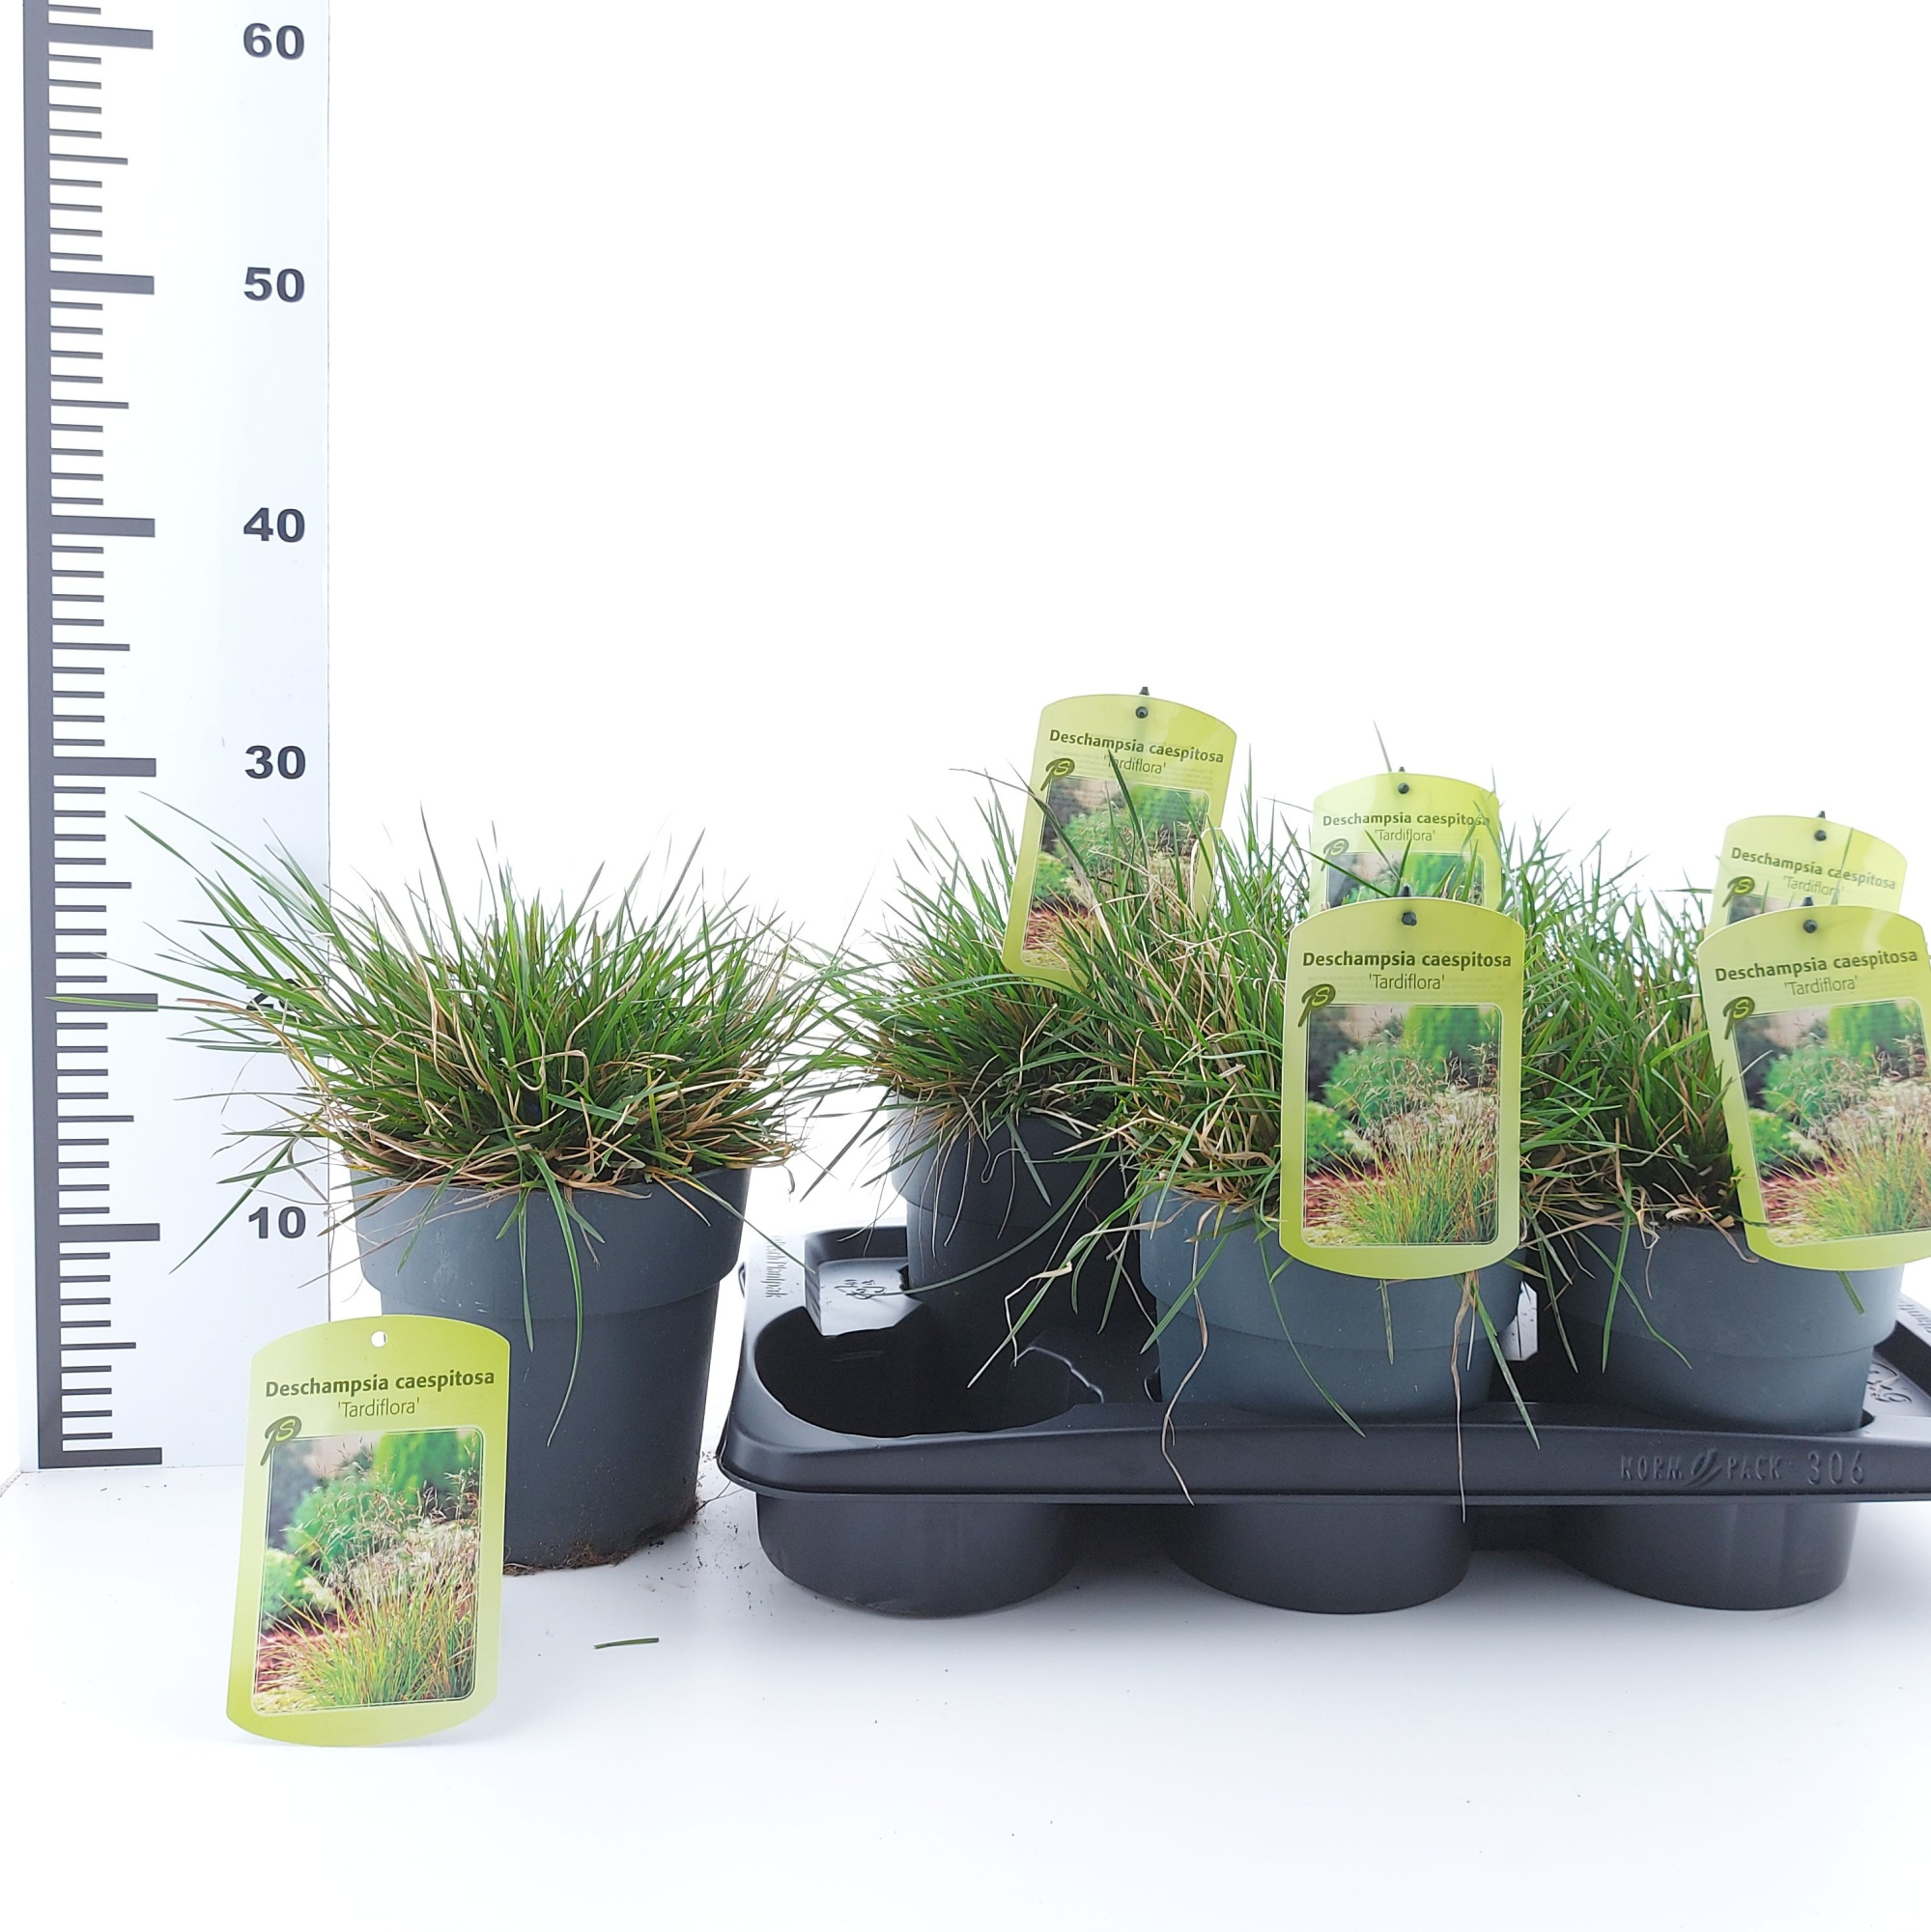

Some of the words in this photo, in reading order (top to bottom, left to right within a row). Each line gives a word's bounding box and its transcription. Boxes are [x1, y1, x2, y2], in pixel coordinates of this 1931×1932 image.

[243, 23, 305, 60] 60
[243, 268, 305, 302] 50
[243, 508, 305, 543] 40
[1049, 729, 1144, 753] Deschampsia
[1150, 742, 1224, 763] caespitosa
[244, 746, 306, 780] 30
[1323, 811, 1411, 827] Deschampsia
[1375, 829, 1435, 842] 'Tardiflora'
[1731, 847, 1823, 875] Deschampsia
[1302, 951, 1415, 971] Deschampsia
[1422, 952, 1512, 971] caespitosa
[1715, 957, 1827, 983] Deschampsia
[1833, 950, 1918, 971] caespitosa
[1369, 973, 1445, 990] 'Tardiflora'
[1784, 975, 1858, 996] 'Tardiflora'
[248, 1207, 306, 1239] 10
[266, 1374, 387, 1397] Deschampsia
[395, 1369, 495, 1392] caespitosa
[338, 1397, 419, 1418] 'Tardiflora'
[1620, 1454, 1684, 1480] NORM
[1726, 1456, 1782, 1480] PACK
[1806, 1450, 1865, 1486] 306
